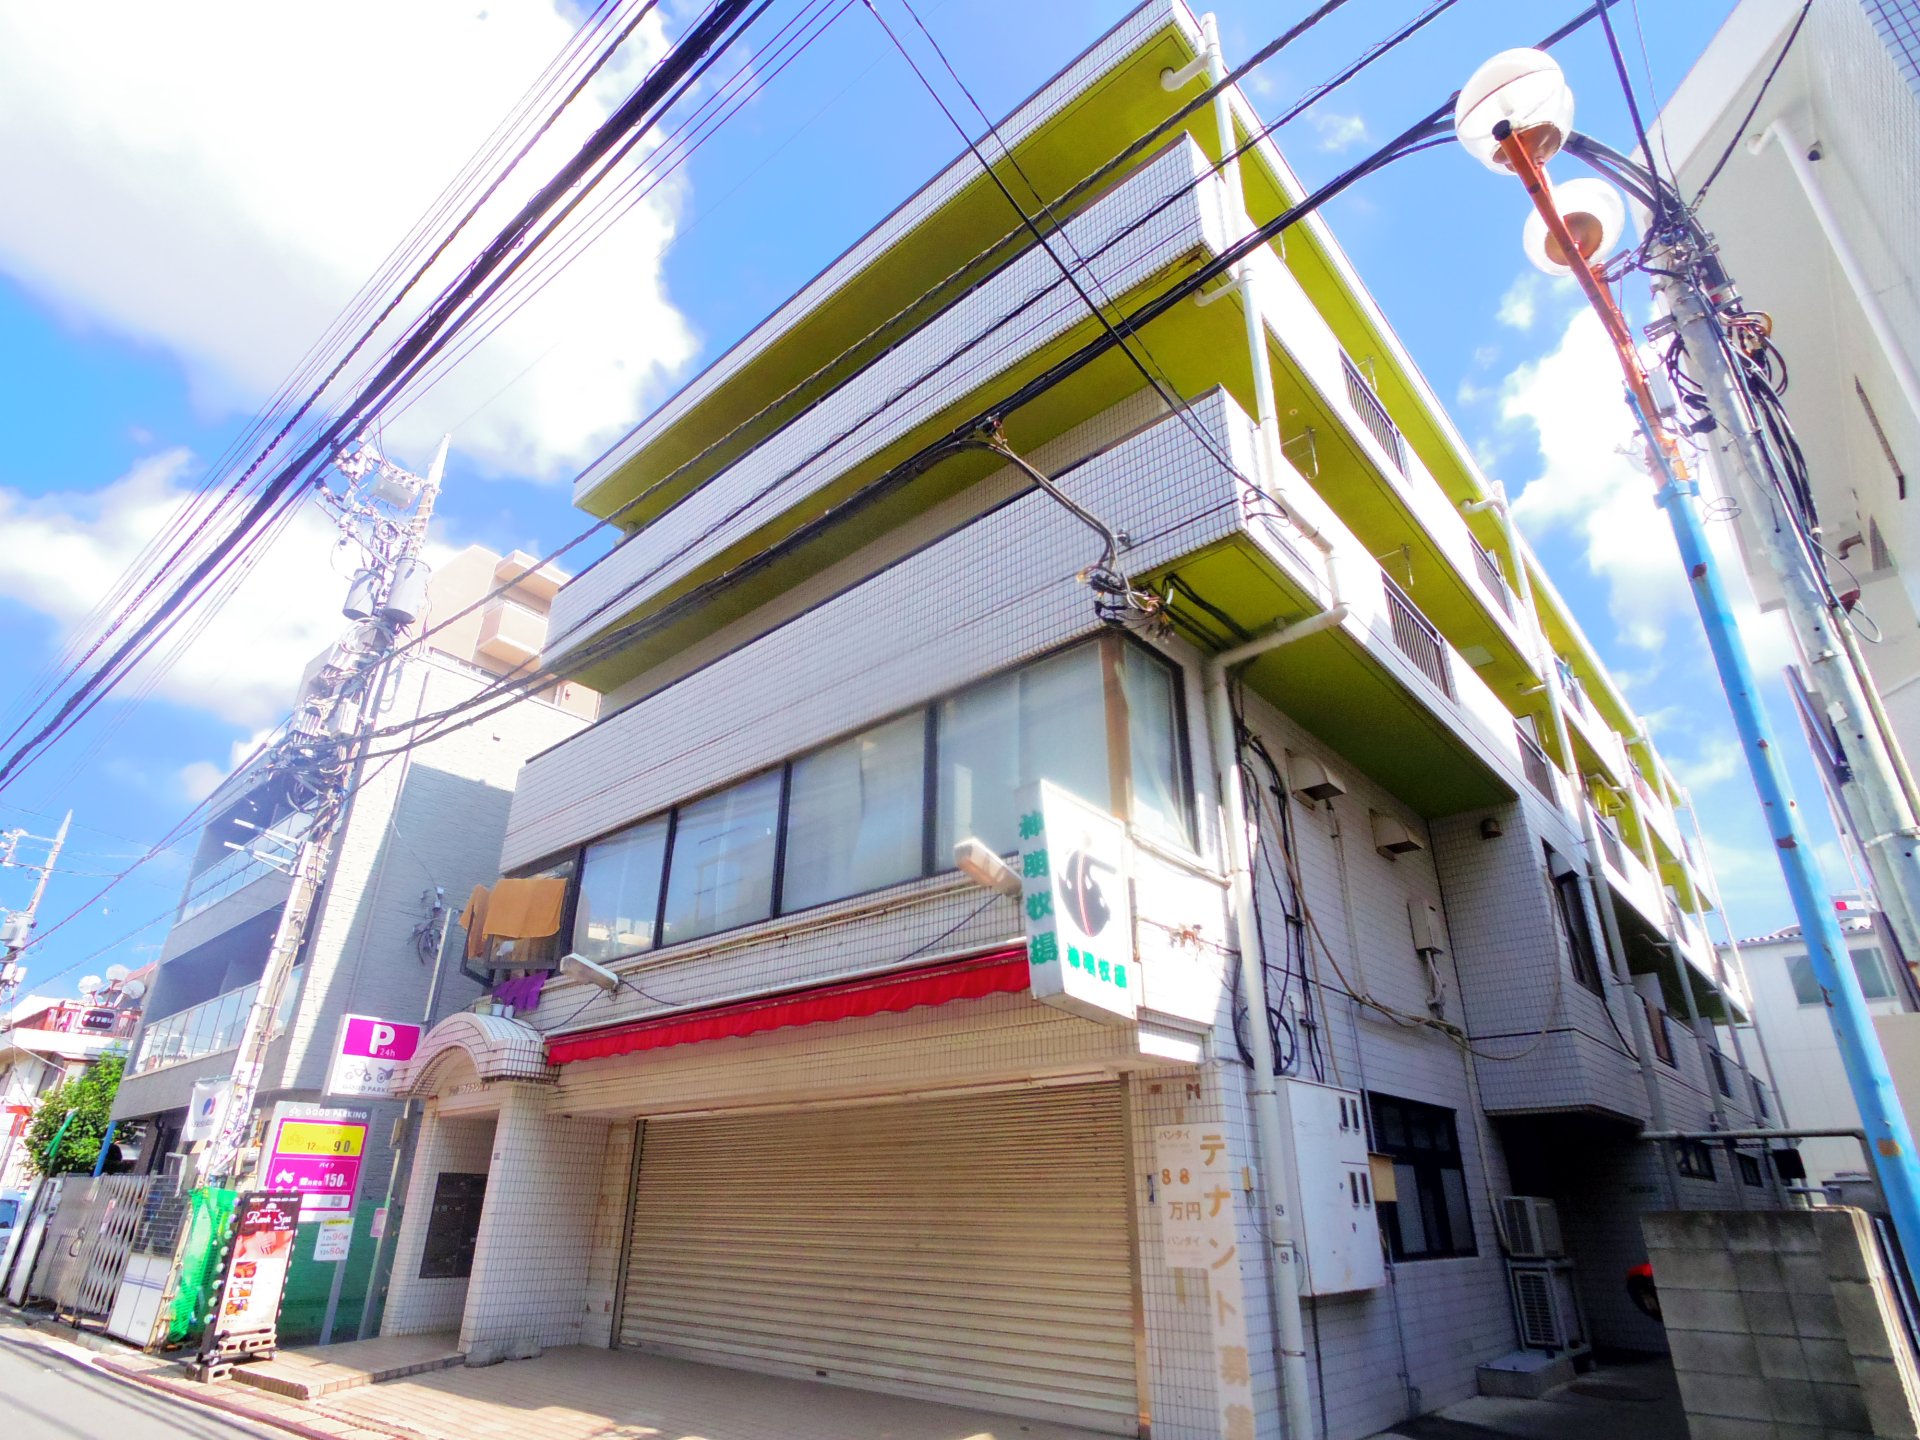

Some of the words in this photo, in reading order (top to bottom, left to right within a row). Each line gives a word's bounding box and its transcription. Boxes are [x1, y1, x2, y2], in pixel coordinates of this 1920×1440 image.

[368, 1023, 396, 1055] P
[380, 1048, 396, 1057] 24h
[305, 1108, 330, 1117] GOOD
[332, 1109, 368, 1120] PARKING
[324, 1173, 345, 1188] 150
[1167, 1201, 1202, 1221] 万円
